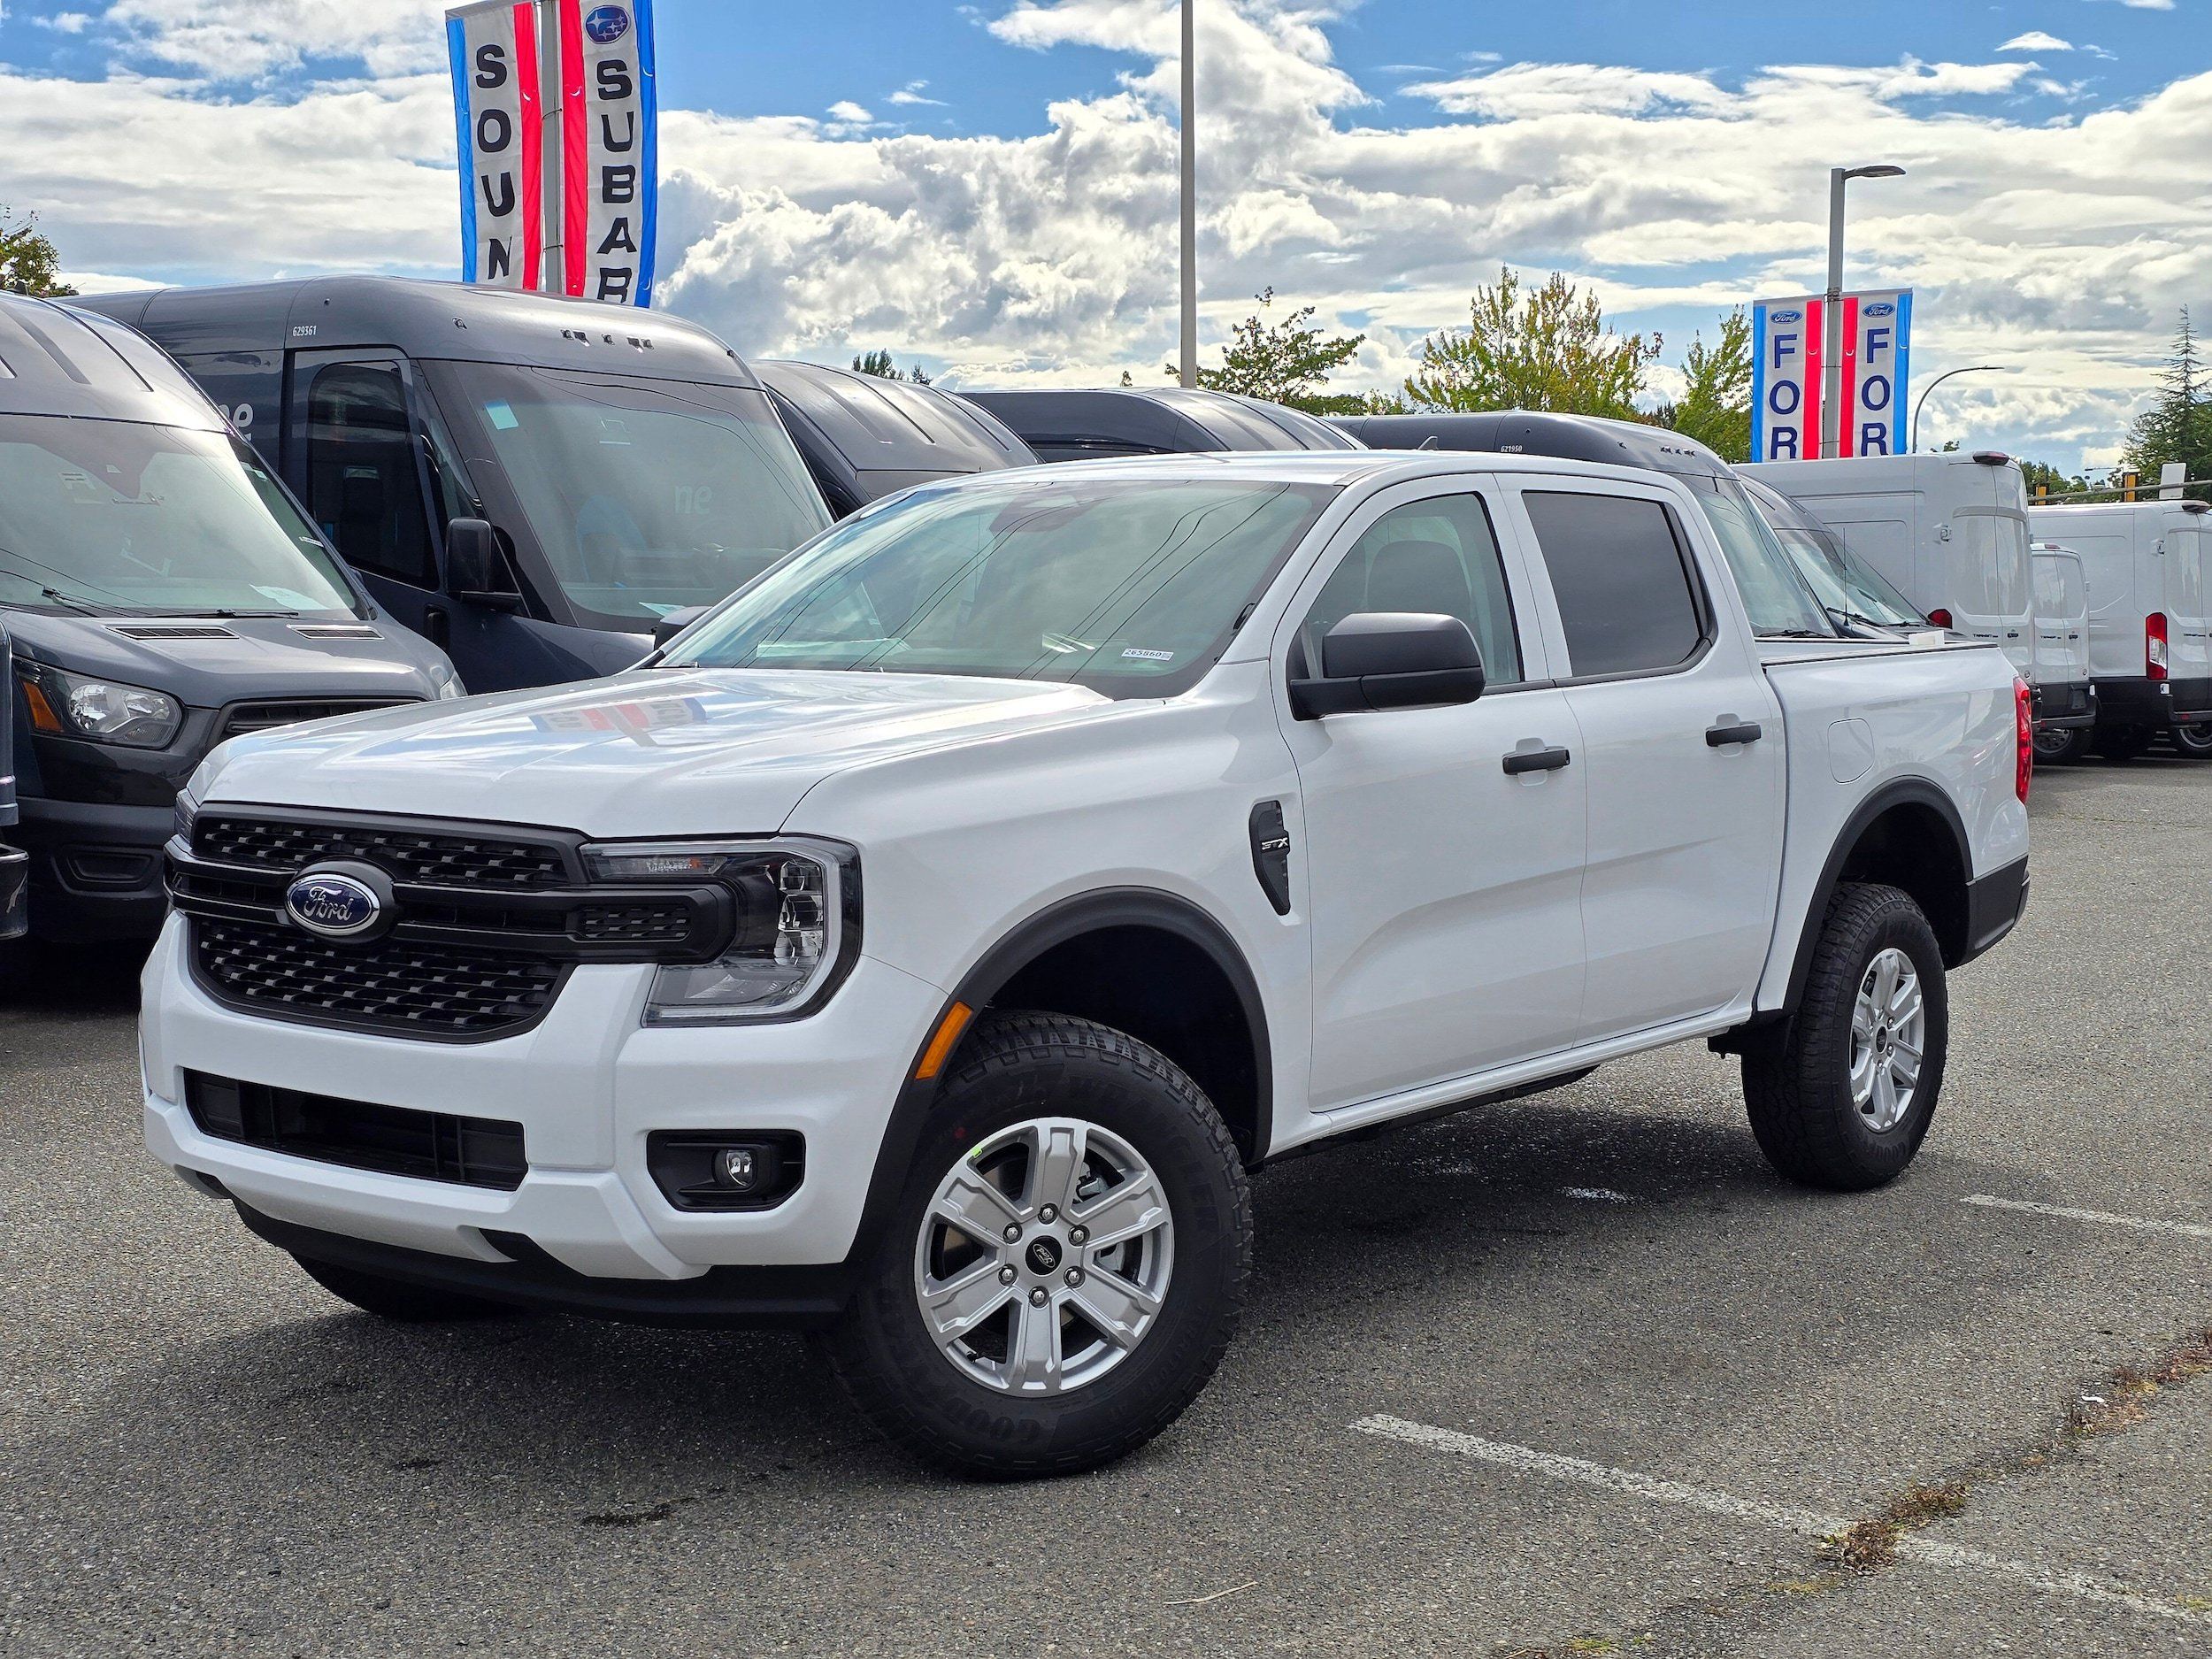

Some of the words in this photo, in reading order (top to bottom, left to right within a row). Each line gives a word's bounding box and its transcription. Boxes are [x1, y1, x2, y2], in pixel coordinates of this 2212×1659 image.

[292, 326, 317, 336] 629361
[1262, 837, 1288, 850] STX
[303, 886, 354, 921] Ford
